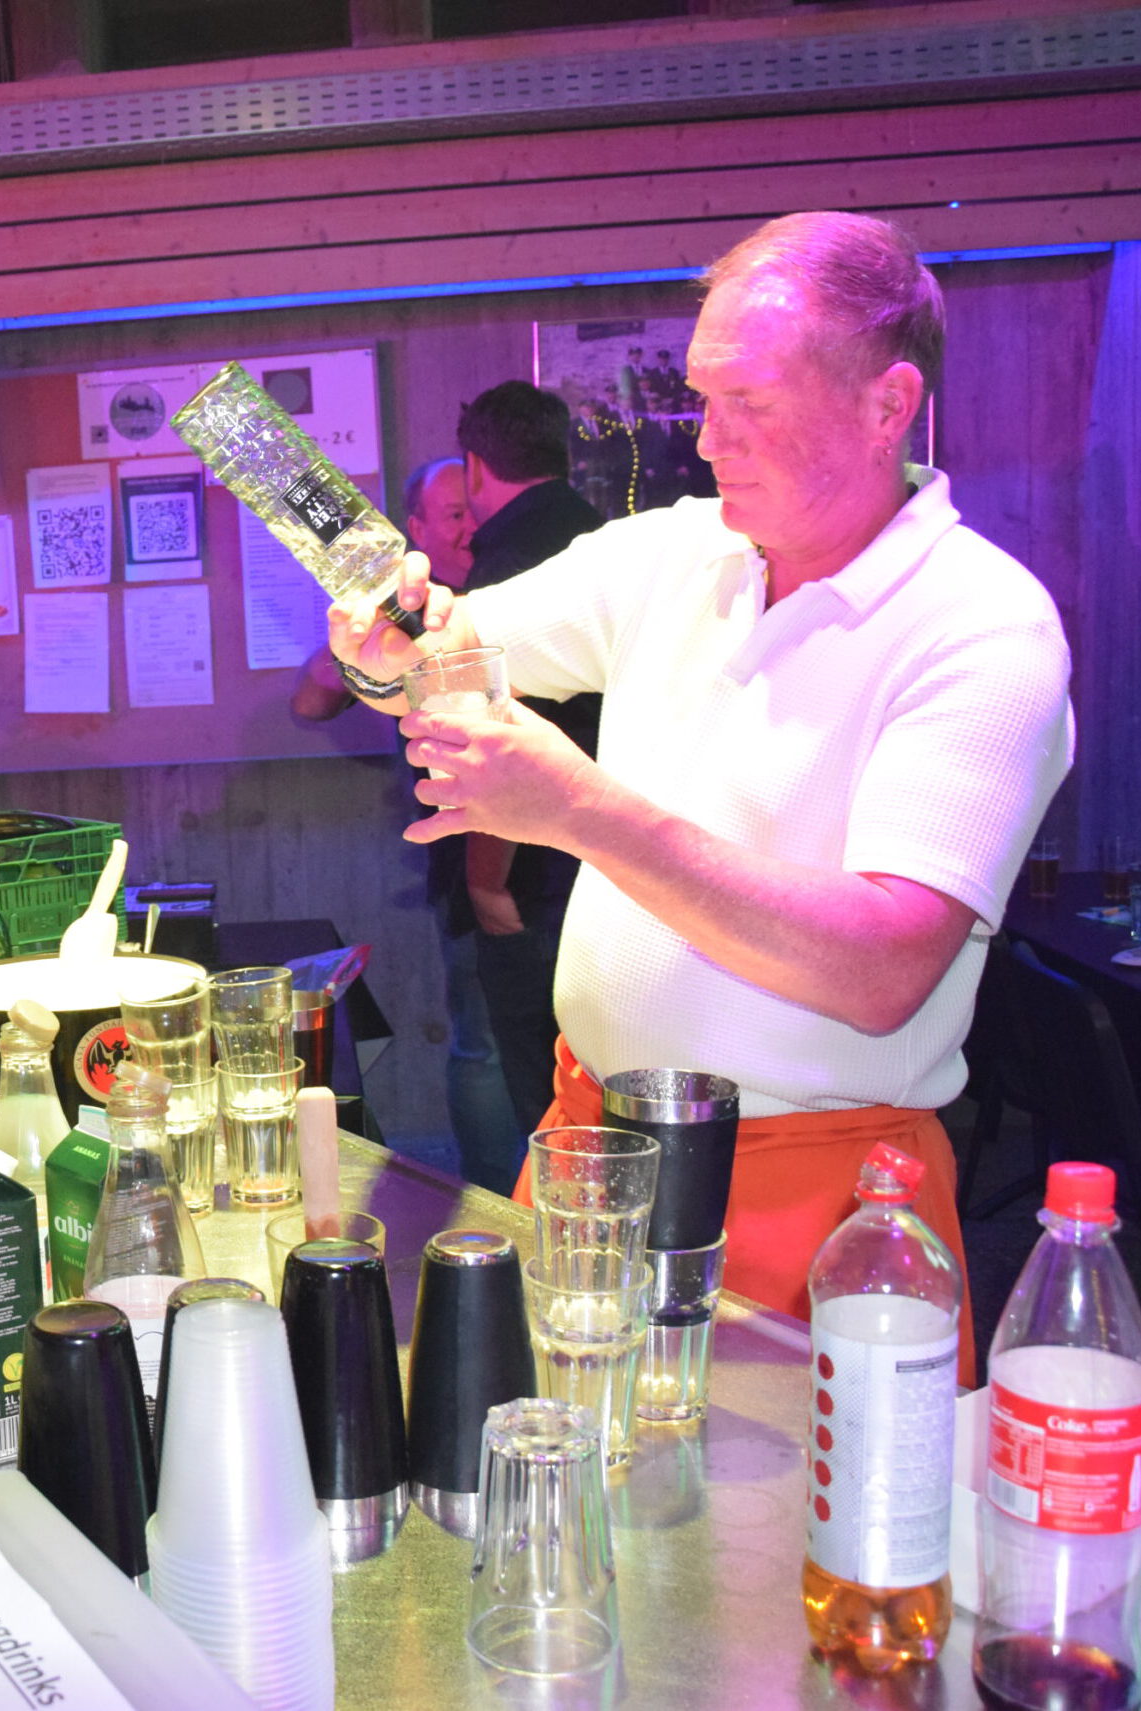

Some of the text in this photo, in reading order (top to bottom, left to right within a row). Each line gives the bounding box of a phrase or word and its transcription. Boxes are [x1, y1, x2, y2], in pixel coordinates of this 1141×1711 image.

[332, 430, 341, 445] 2
[73, 1145, 101, 1160] ANANAS
[54, 1215, 93, 1243] albi
